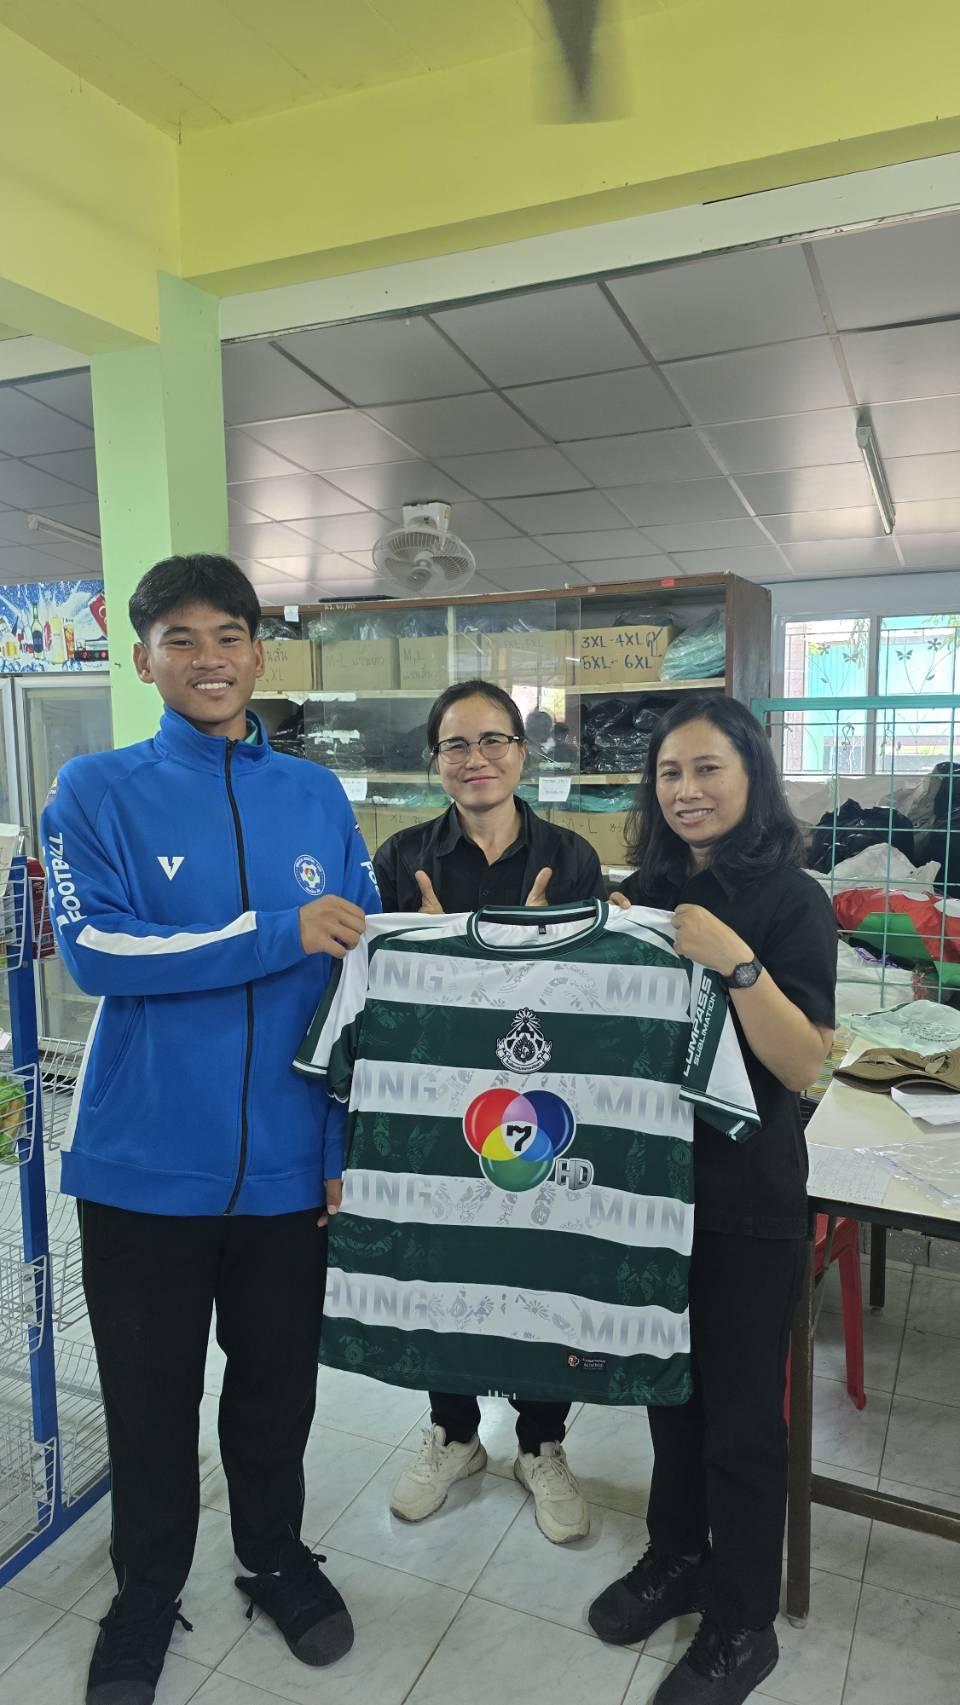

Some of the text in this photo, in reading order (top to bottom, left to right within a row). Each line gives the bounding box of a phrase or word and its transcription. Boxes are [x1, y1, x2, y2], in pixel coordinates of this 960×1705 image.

[682, 974, 712, 1078] LUMPASS
[693, 991, 717, 1067] SUBLIMATION
[506, 1124, 532, 1152] 7
[555, 1158, 594, 1192] HD
